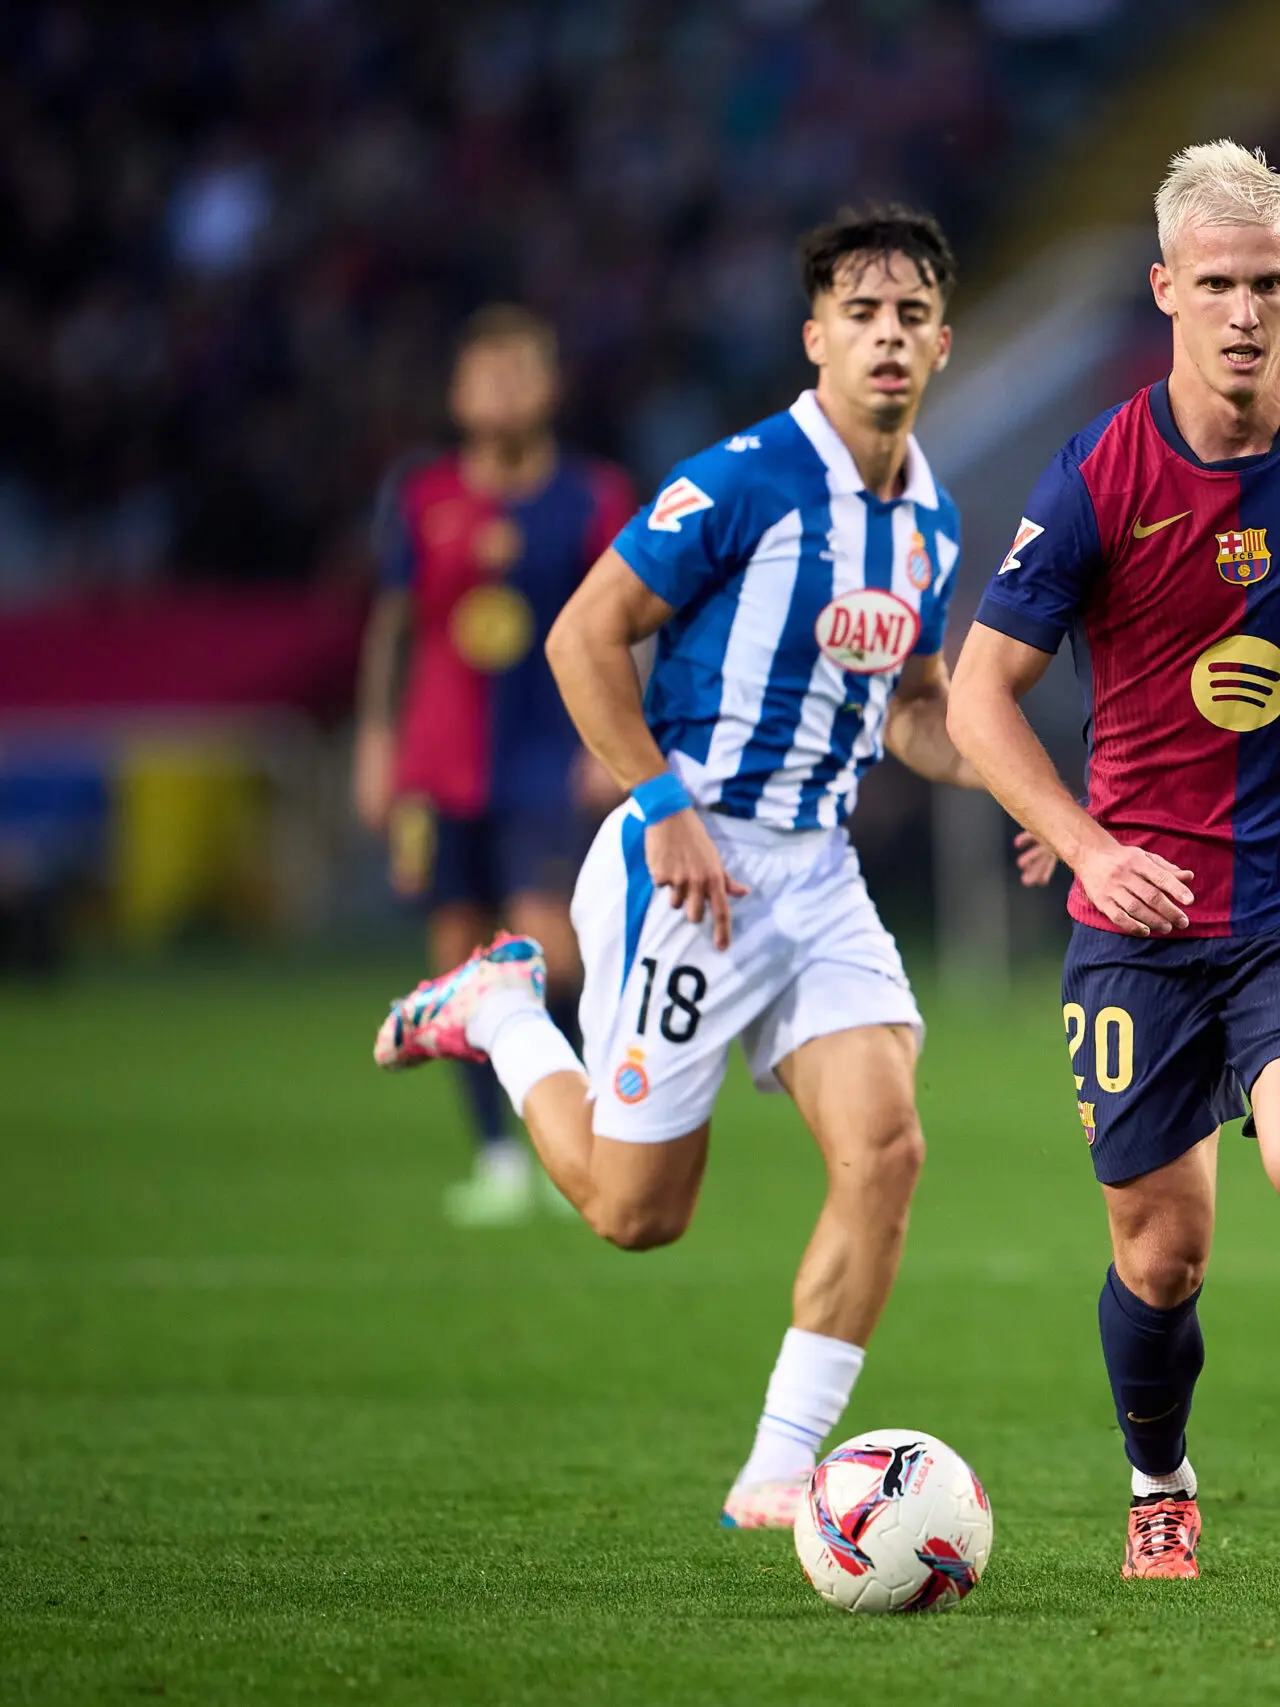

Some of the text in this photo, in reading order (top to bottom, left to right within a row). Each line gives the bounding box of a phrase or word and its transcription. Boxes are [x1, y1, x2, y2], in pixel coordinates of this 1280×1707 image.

[1232, 552, 1254, 561] FCB
[827, 606, 907, 656] DANI
[637, 956, 707, 1044] 18
[1062, 1002, 1134, 1093] 20
